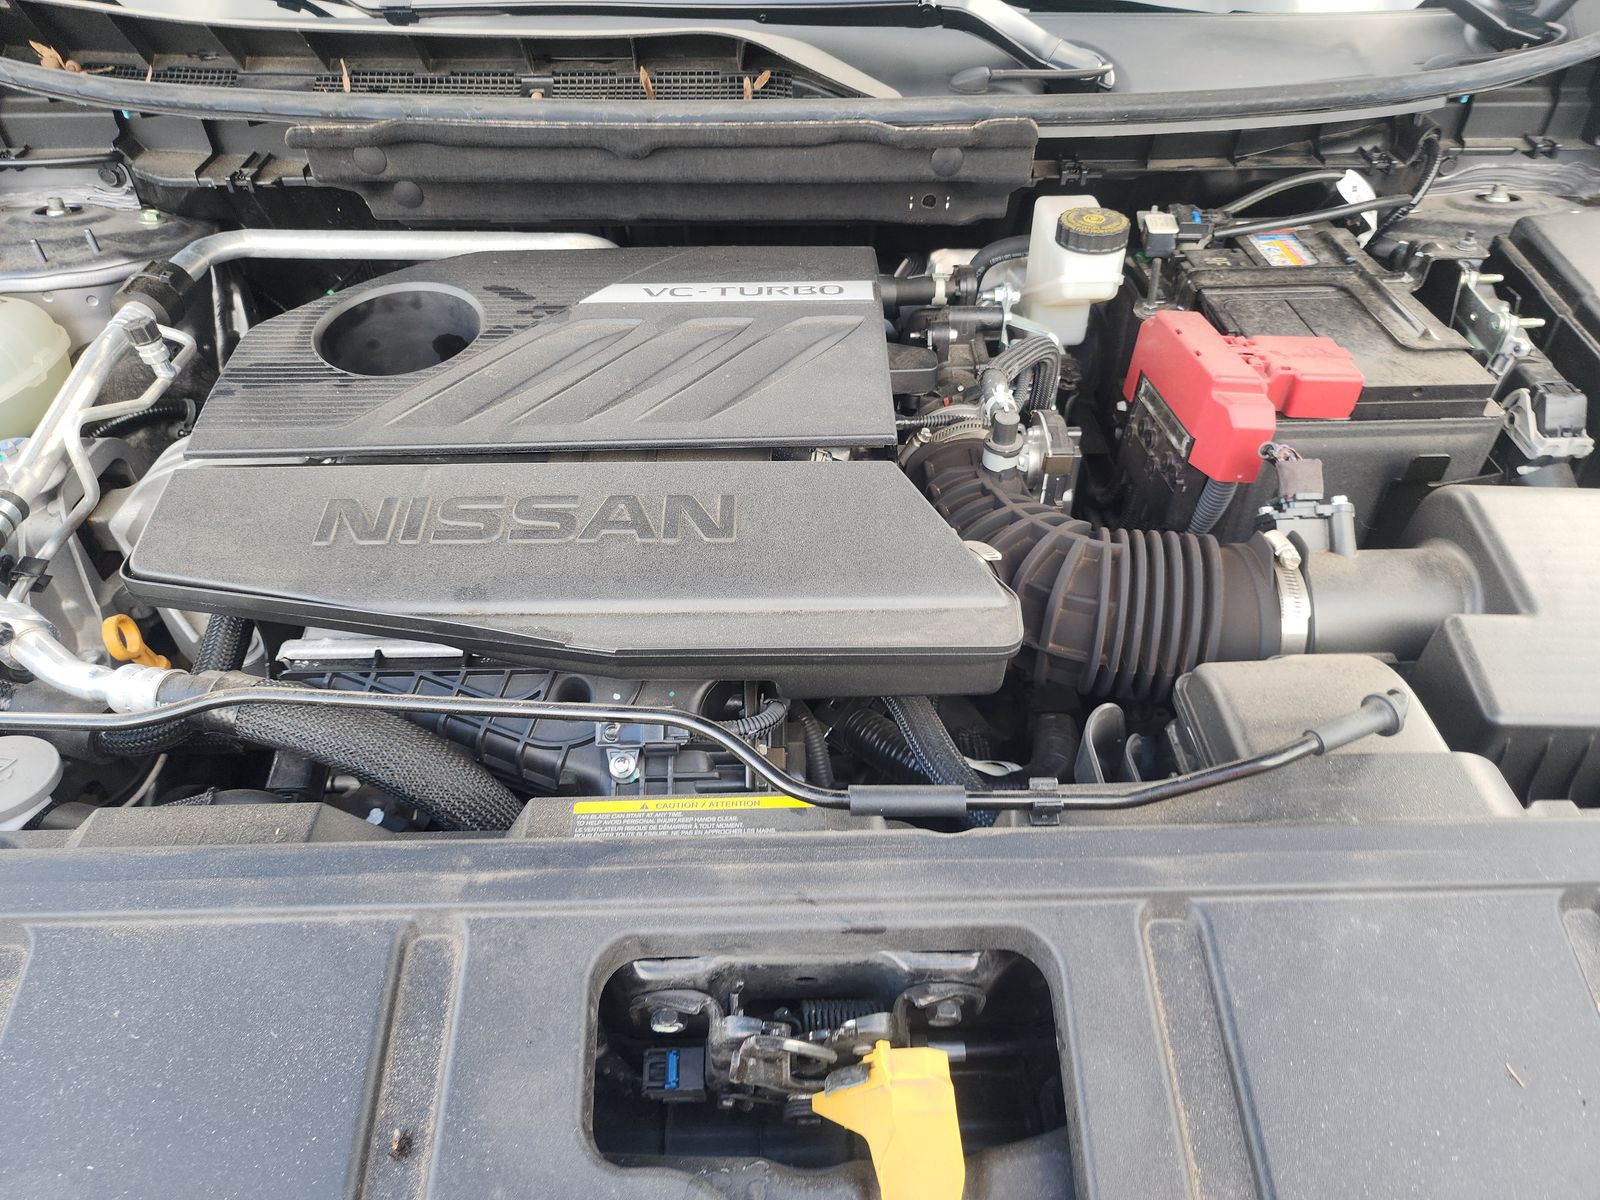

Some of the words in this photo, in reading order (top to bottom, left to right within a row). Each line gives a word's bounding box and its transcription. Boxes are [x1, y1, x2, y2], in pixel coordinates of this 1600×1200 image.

[642, 284, 844, 297] VC-TURBO
[312, 494, 738, 546] NISSAN
[658, 822, 693, 830] DÉMARRER
